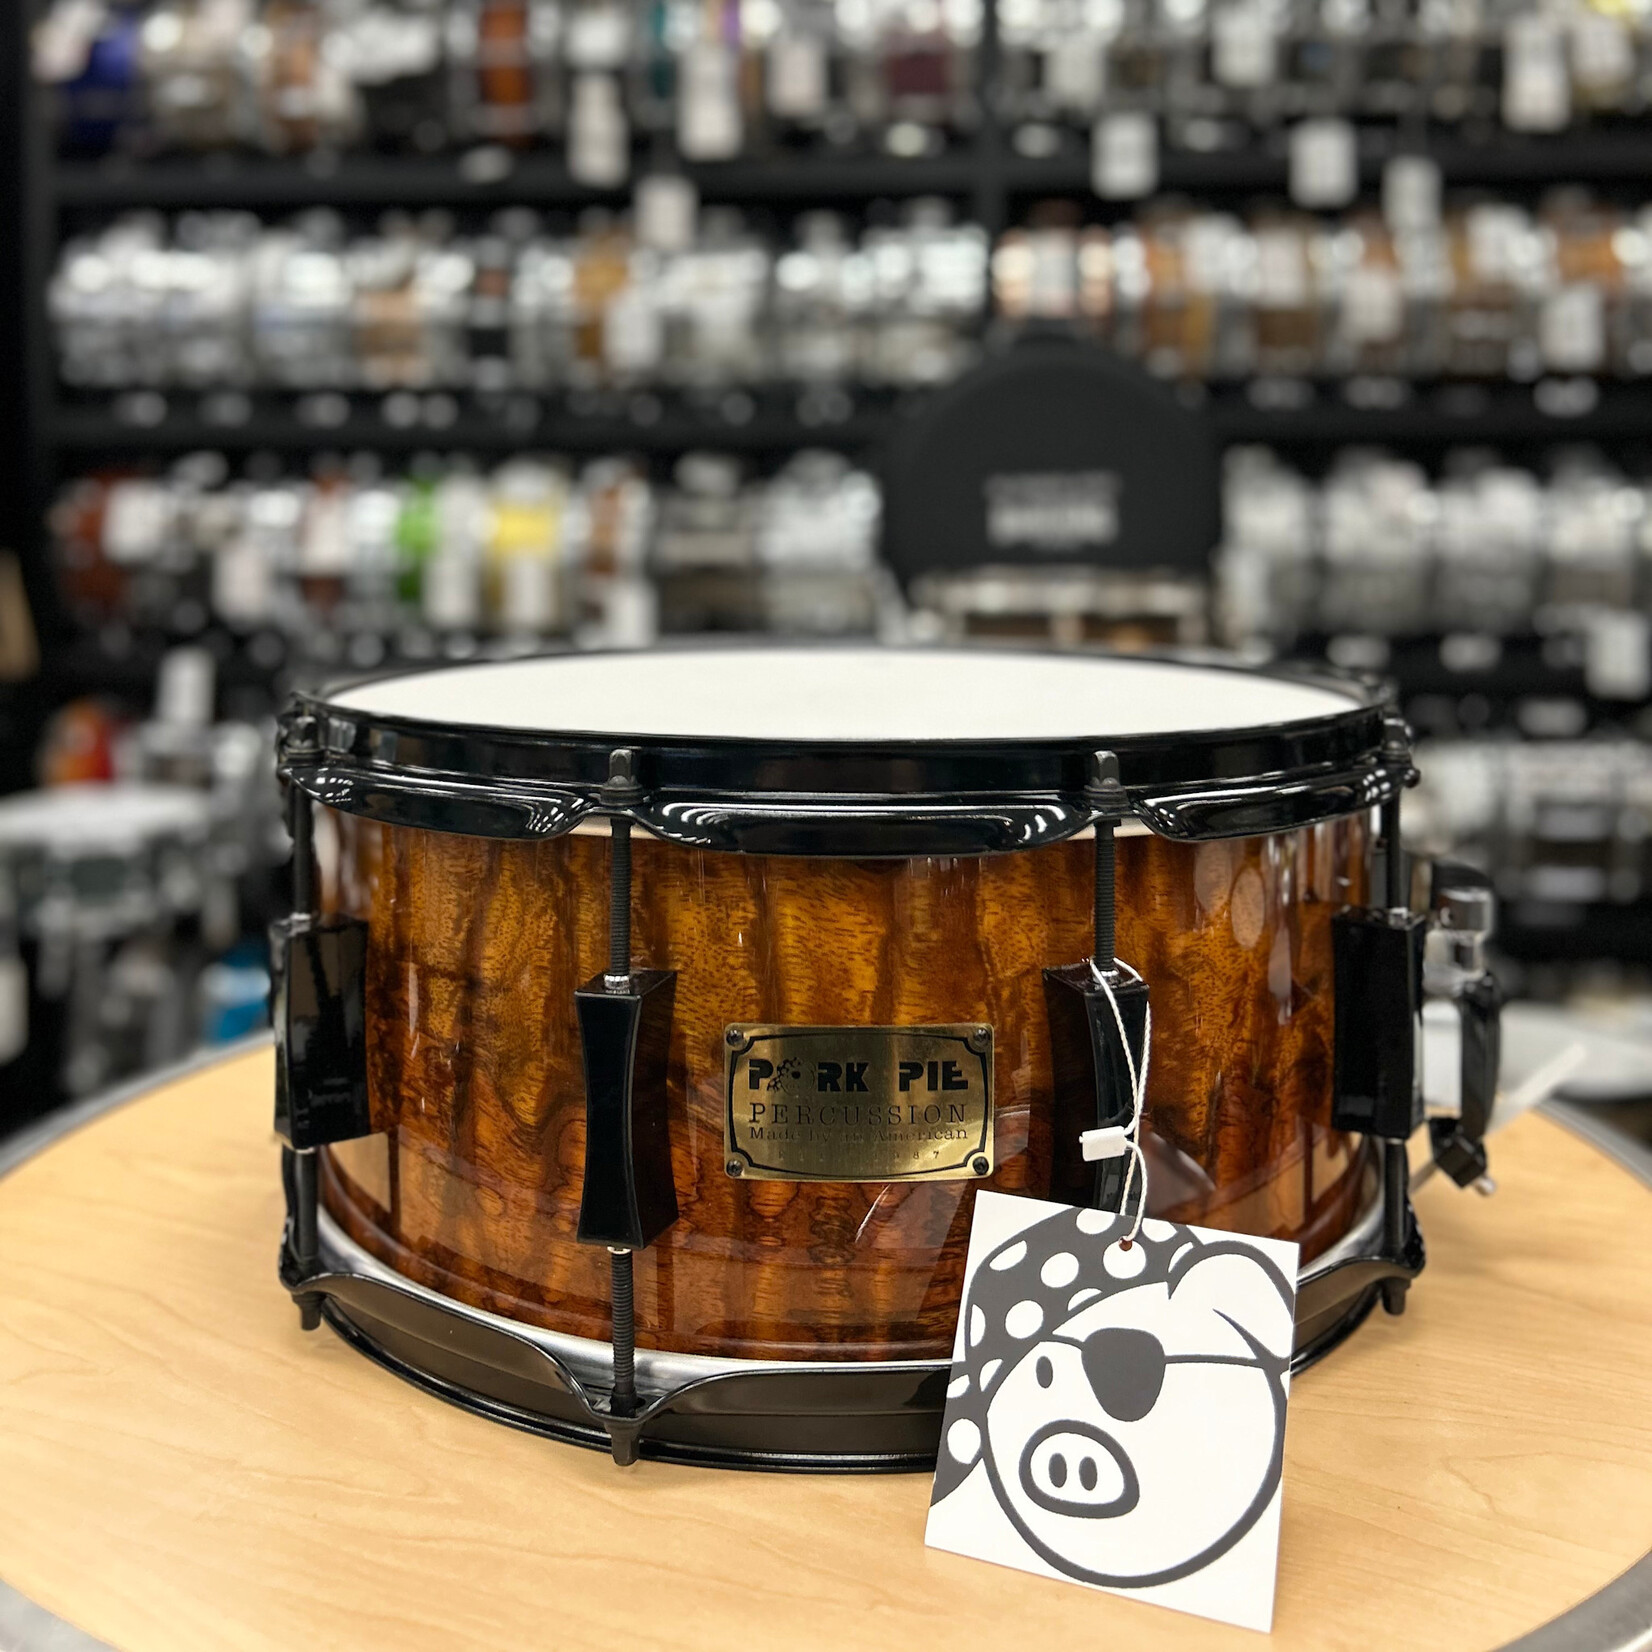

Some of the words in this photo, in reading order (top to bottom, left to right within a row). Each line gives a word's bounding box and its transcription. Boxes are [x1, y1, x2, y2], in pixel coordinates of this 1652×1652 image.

[898, 1060, 969, 1092] PIE
[748, 1103, 967, 1126] PERCUSSION
[749, 1126, 801, 1141] Made
[873, 1127, 968, 1143] American
